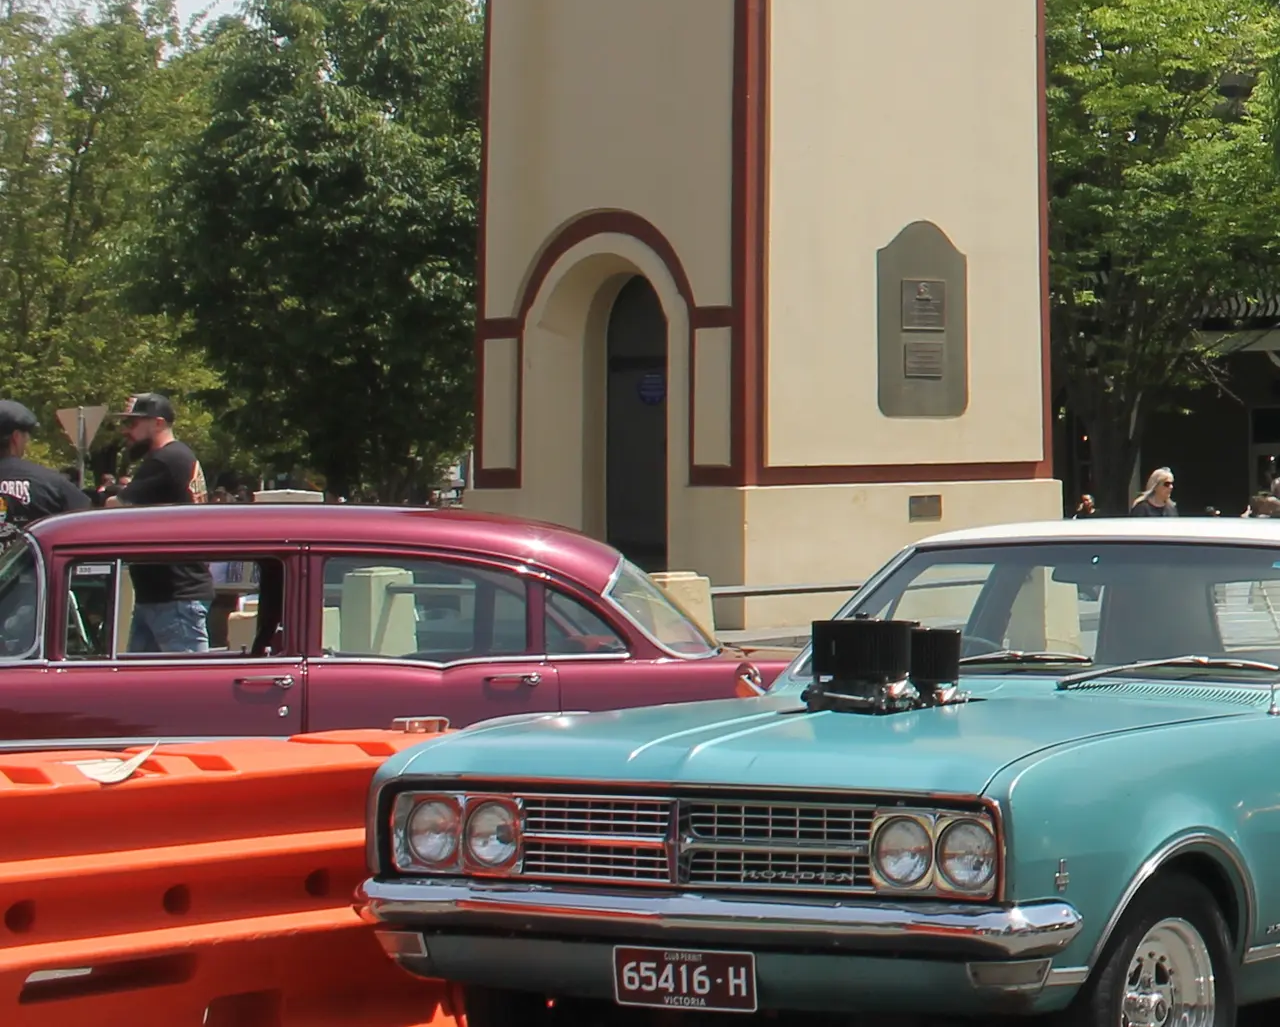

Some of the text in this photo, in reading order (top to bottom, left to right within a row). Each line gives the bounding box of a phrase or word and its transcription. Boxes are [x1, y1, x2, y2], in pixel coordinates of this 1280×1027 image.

[741, 869, 855, 882] HOLDEN
[664, 951, 680, 961] CLUB
[664, 996, 706, 1007] VICTORIA
